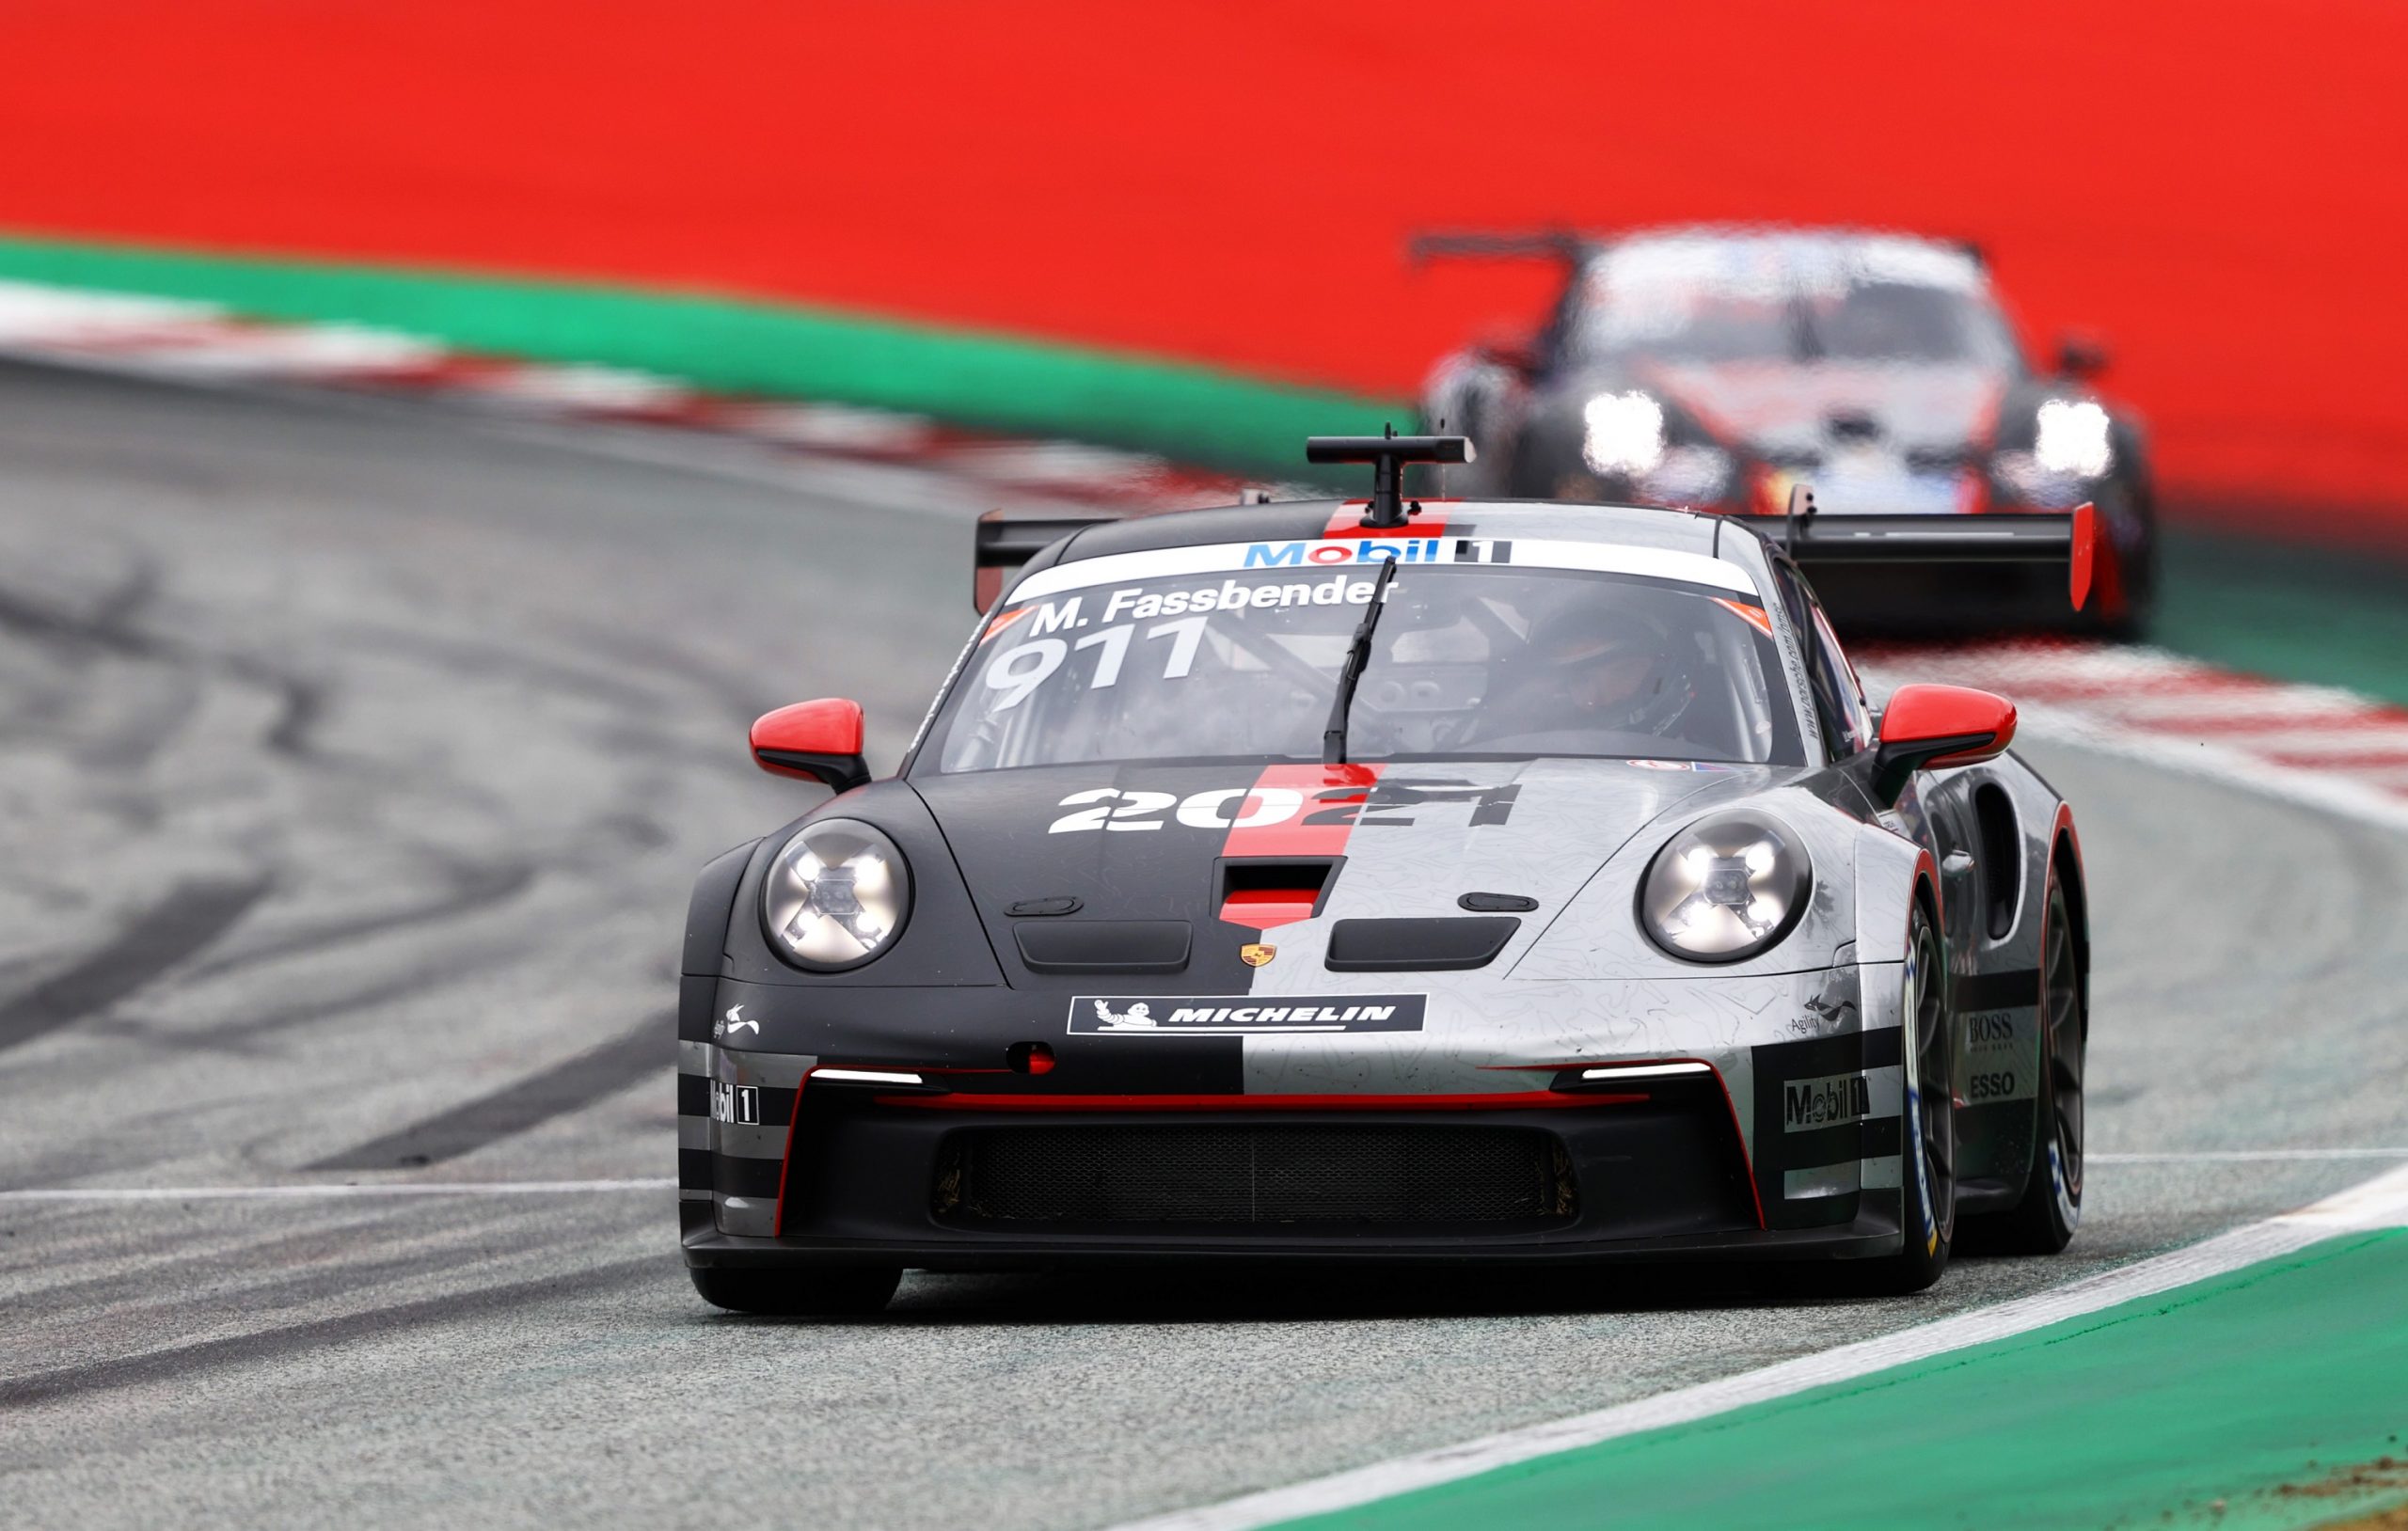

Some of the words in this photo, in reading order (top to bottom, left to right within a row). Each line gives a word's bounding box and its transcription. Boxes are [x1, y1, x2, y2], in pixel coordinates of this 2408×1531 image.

[1244, 539, 1439, 567] Mobil
[1029, 597, 1088, 638] M.
[1102, 575, 1399, 622] Fassbender
[985, 616, 1208, 712] 911
[1048, 783, 1522, 834] 2021
[1168, 1004, 1396, 1023] MICHELIN
[1792, 1016, 1820, 1034] Agility
[1970, 1013, 2013, 1042] BOSS
[1971, 1072, 2015, 1098] ESSO
[1787, 1081, 1847, 1125] Mobil
